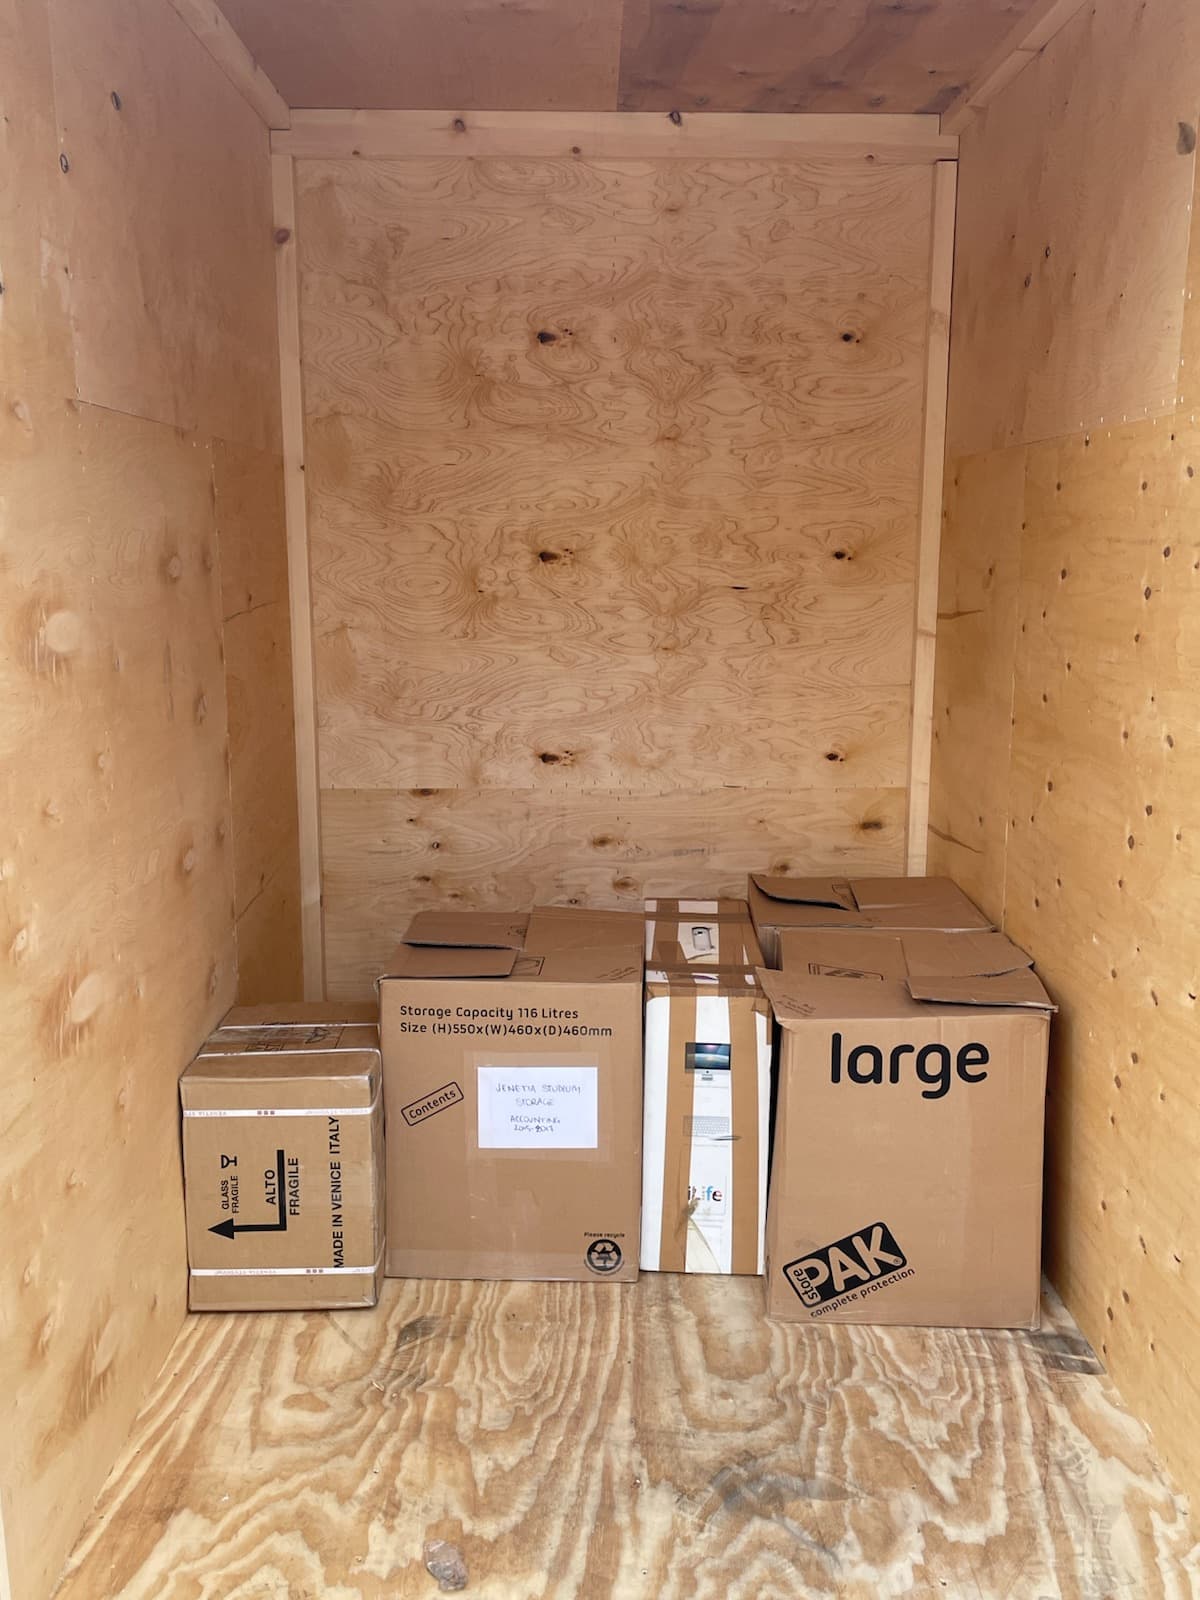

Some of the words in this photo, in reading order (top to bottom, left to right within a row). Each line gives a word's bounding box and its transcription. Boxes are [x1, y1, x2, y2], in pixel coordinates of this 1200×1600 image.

[400, 1005, 452, 1019] Storage
[456, 1007, 513, 1020] Capacity
[518, 1008, 538, 1018] 116
[541, 1008, 579, 1019] Litres
[400, 1022, 427, 1033] Size
[432, 1023, 613, 1036] (H)550x(W)460x(D)460mm
[831, 1032, 990, 1099] large
[409, 1090, 456, 1119] Contents
[329, 1116, 340, 1154] ITALY
[221, 1180, 229, 1209] GLASS
[231, 1175, 239, 1214] FRAGILE
[264, 1169, 276, 1205] ALTO
[288, 1157, 300, 1216] FRAGILE
[330, 1161, 342, 1210] VENICE
[332, 1214, 343, 1227] IN
[333, 1231, 344, 1268] MADE
[786, 1225, 903, 1307] PAK
[793, 1268, 818, 1300] store
[810, 1293, 858, 1318] complete
[860, 1267, 916, 1298] protection
